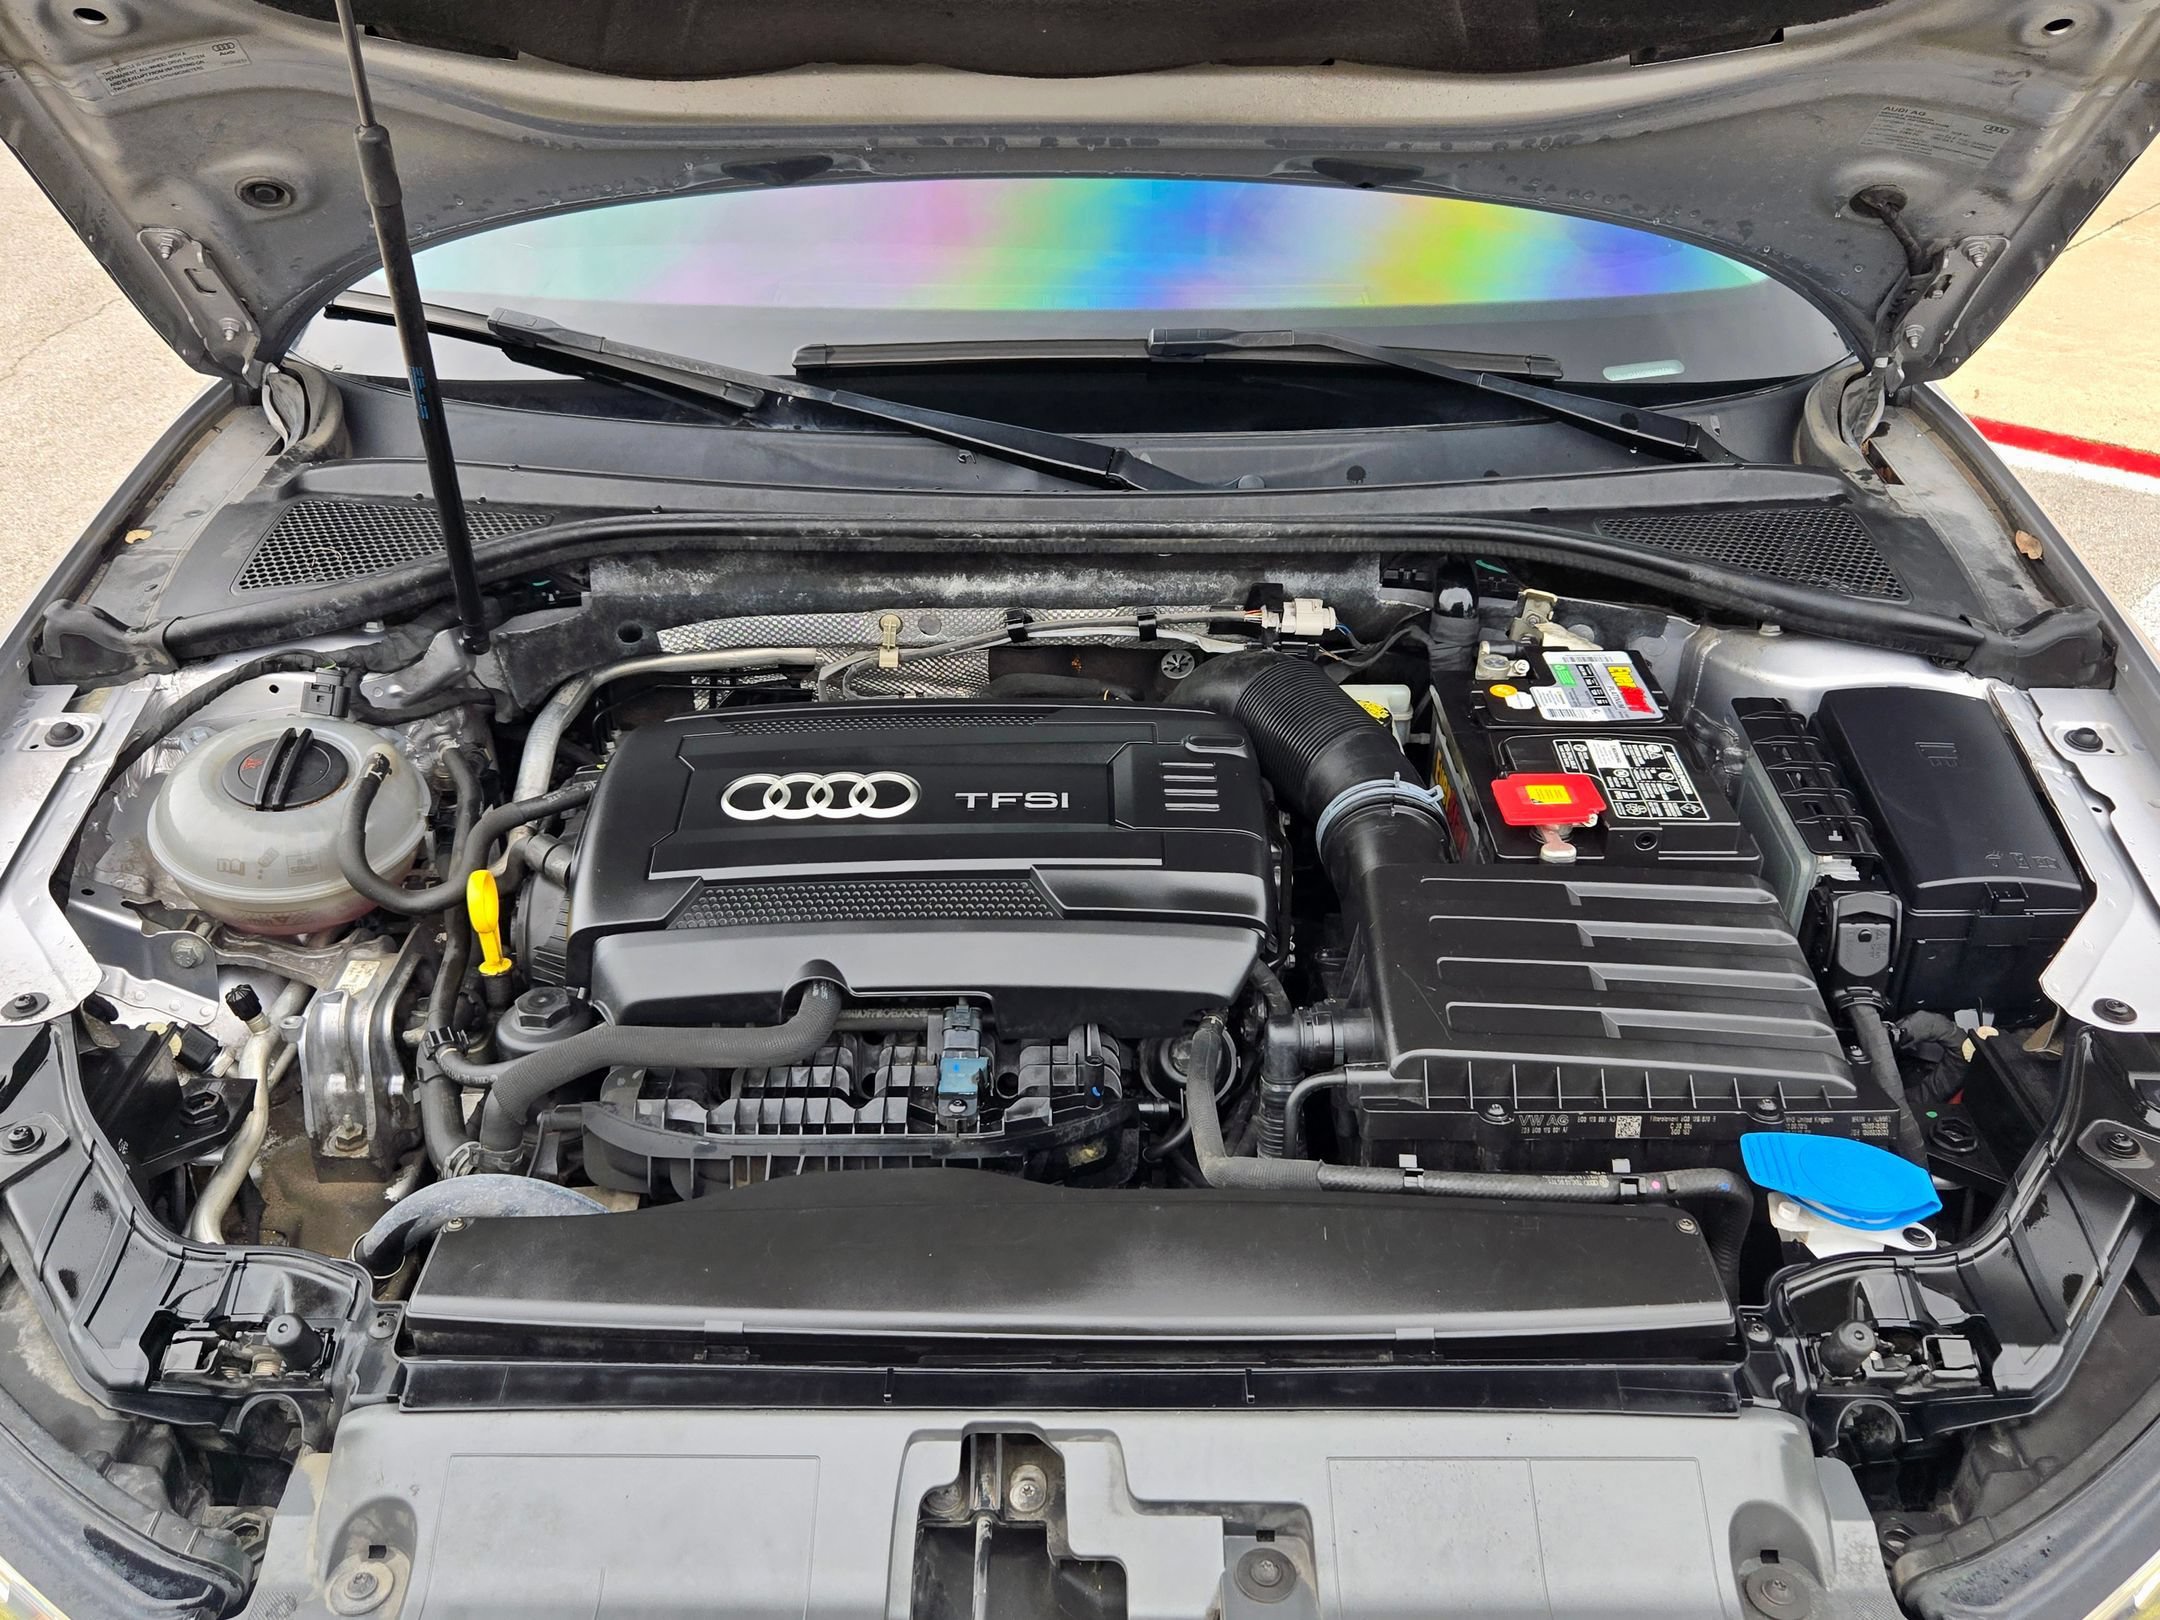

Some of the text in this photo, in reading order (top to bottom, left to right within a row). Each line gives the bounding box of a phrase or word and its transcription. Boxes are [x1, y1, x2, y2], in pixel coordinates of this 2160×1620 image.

[116, 64, 135, 73] VEHICLE
[1609, 685, 1627, 710] PLATINUM
[955, 791, 1069, 811] TFSI
[1519, 1114, 1569, 1126] VW AG
